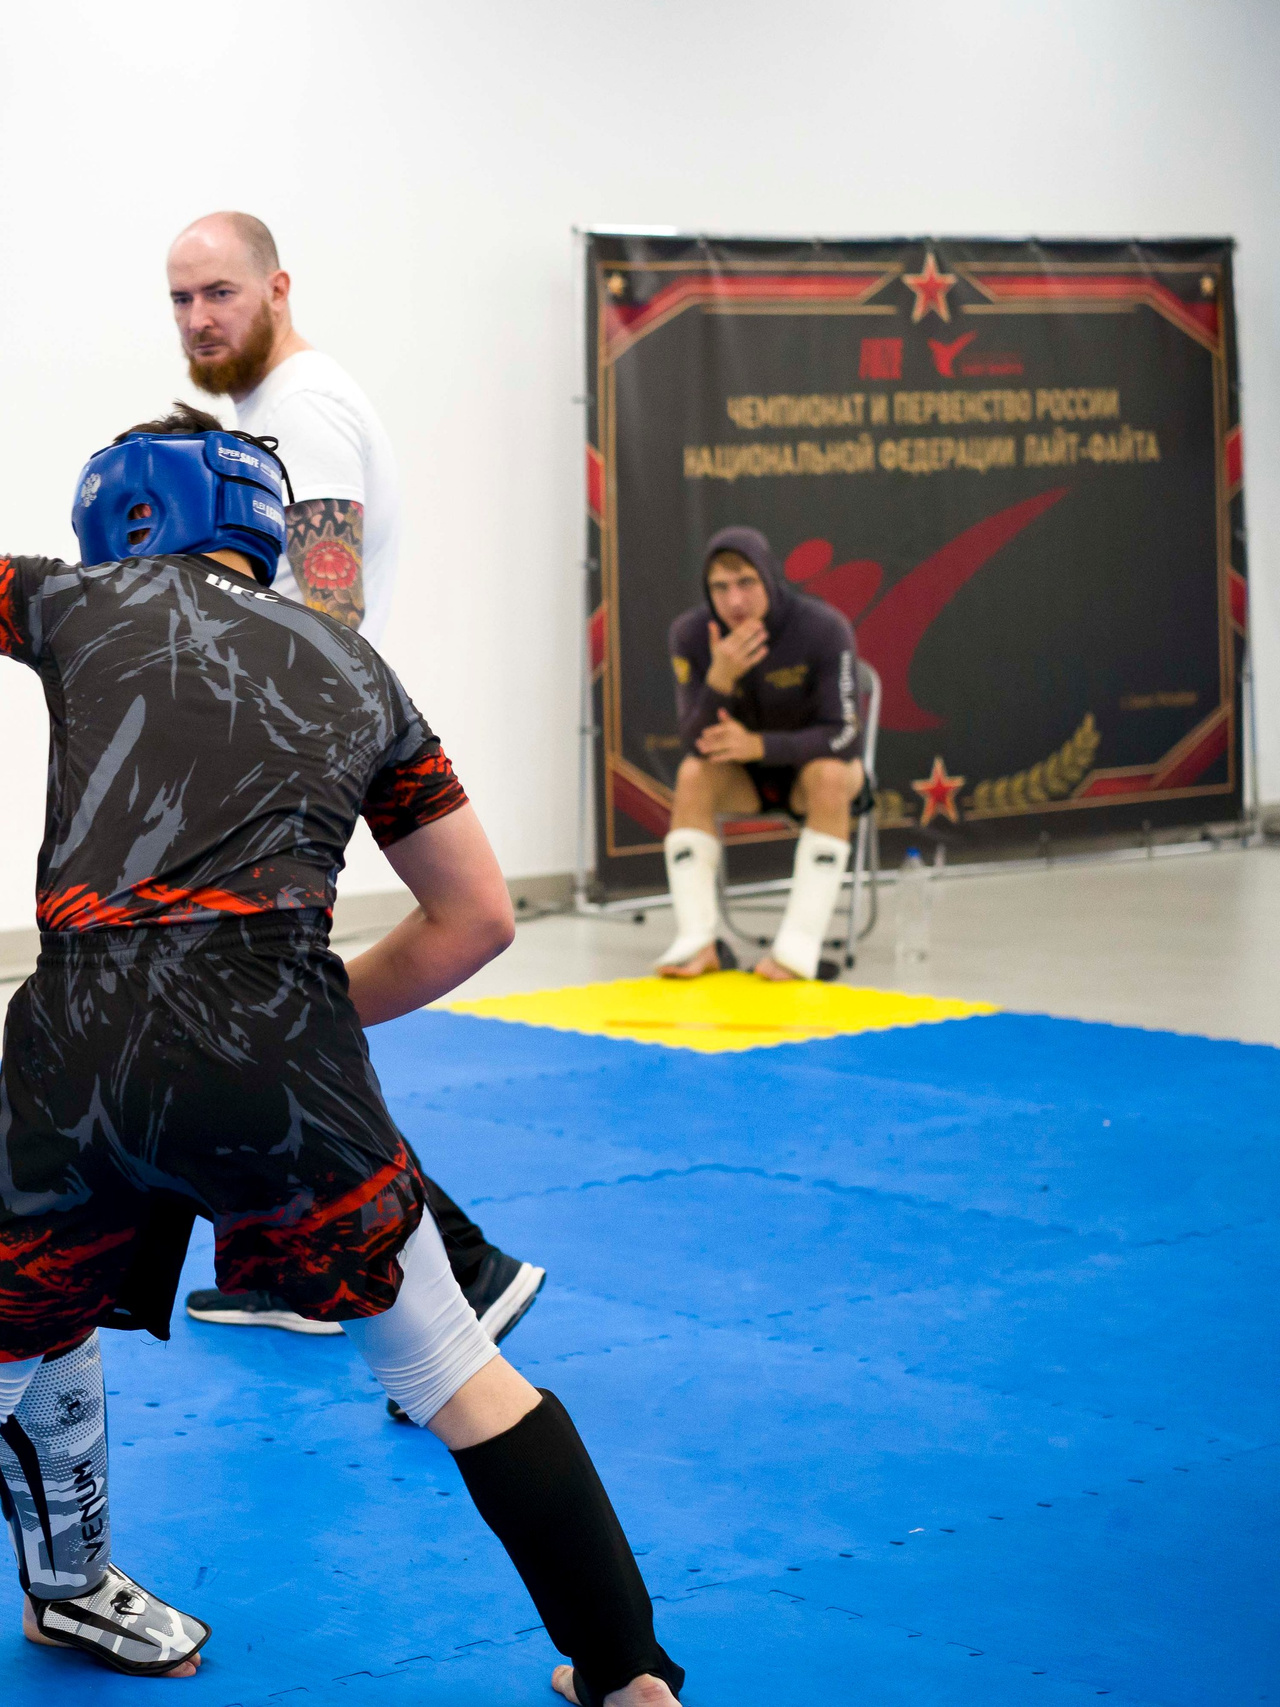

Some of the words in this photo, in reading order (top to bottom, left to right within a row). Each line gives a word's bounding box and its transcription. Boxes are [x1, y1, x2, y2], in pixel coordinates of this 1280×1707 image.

[727, 393, 865, 429] ЧЕМПИОНАТ
[871, 394, 889, 424] И
[893, 390, 1032, 425] ПЕРВЕНСТВО
[1036, 388, 1119, 421] РОССИИ
[239, 453, 259, 468] SAFE
[683, 432, 875, 483] НАЦИОНАЛЬНОЙ
[879, 436, 1016, 475] ФЕДЕРАЦИИ
[1024, 424, 1161, 468] ЛАЙТ-ФАЙТА
[72, 1460, 106, 1563] VENUM
